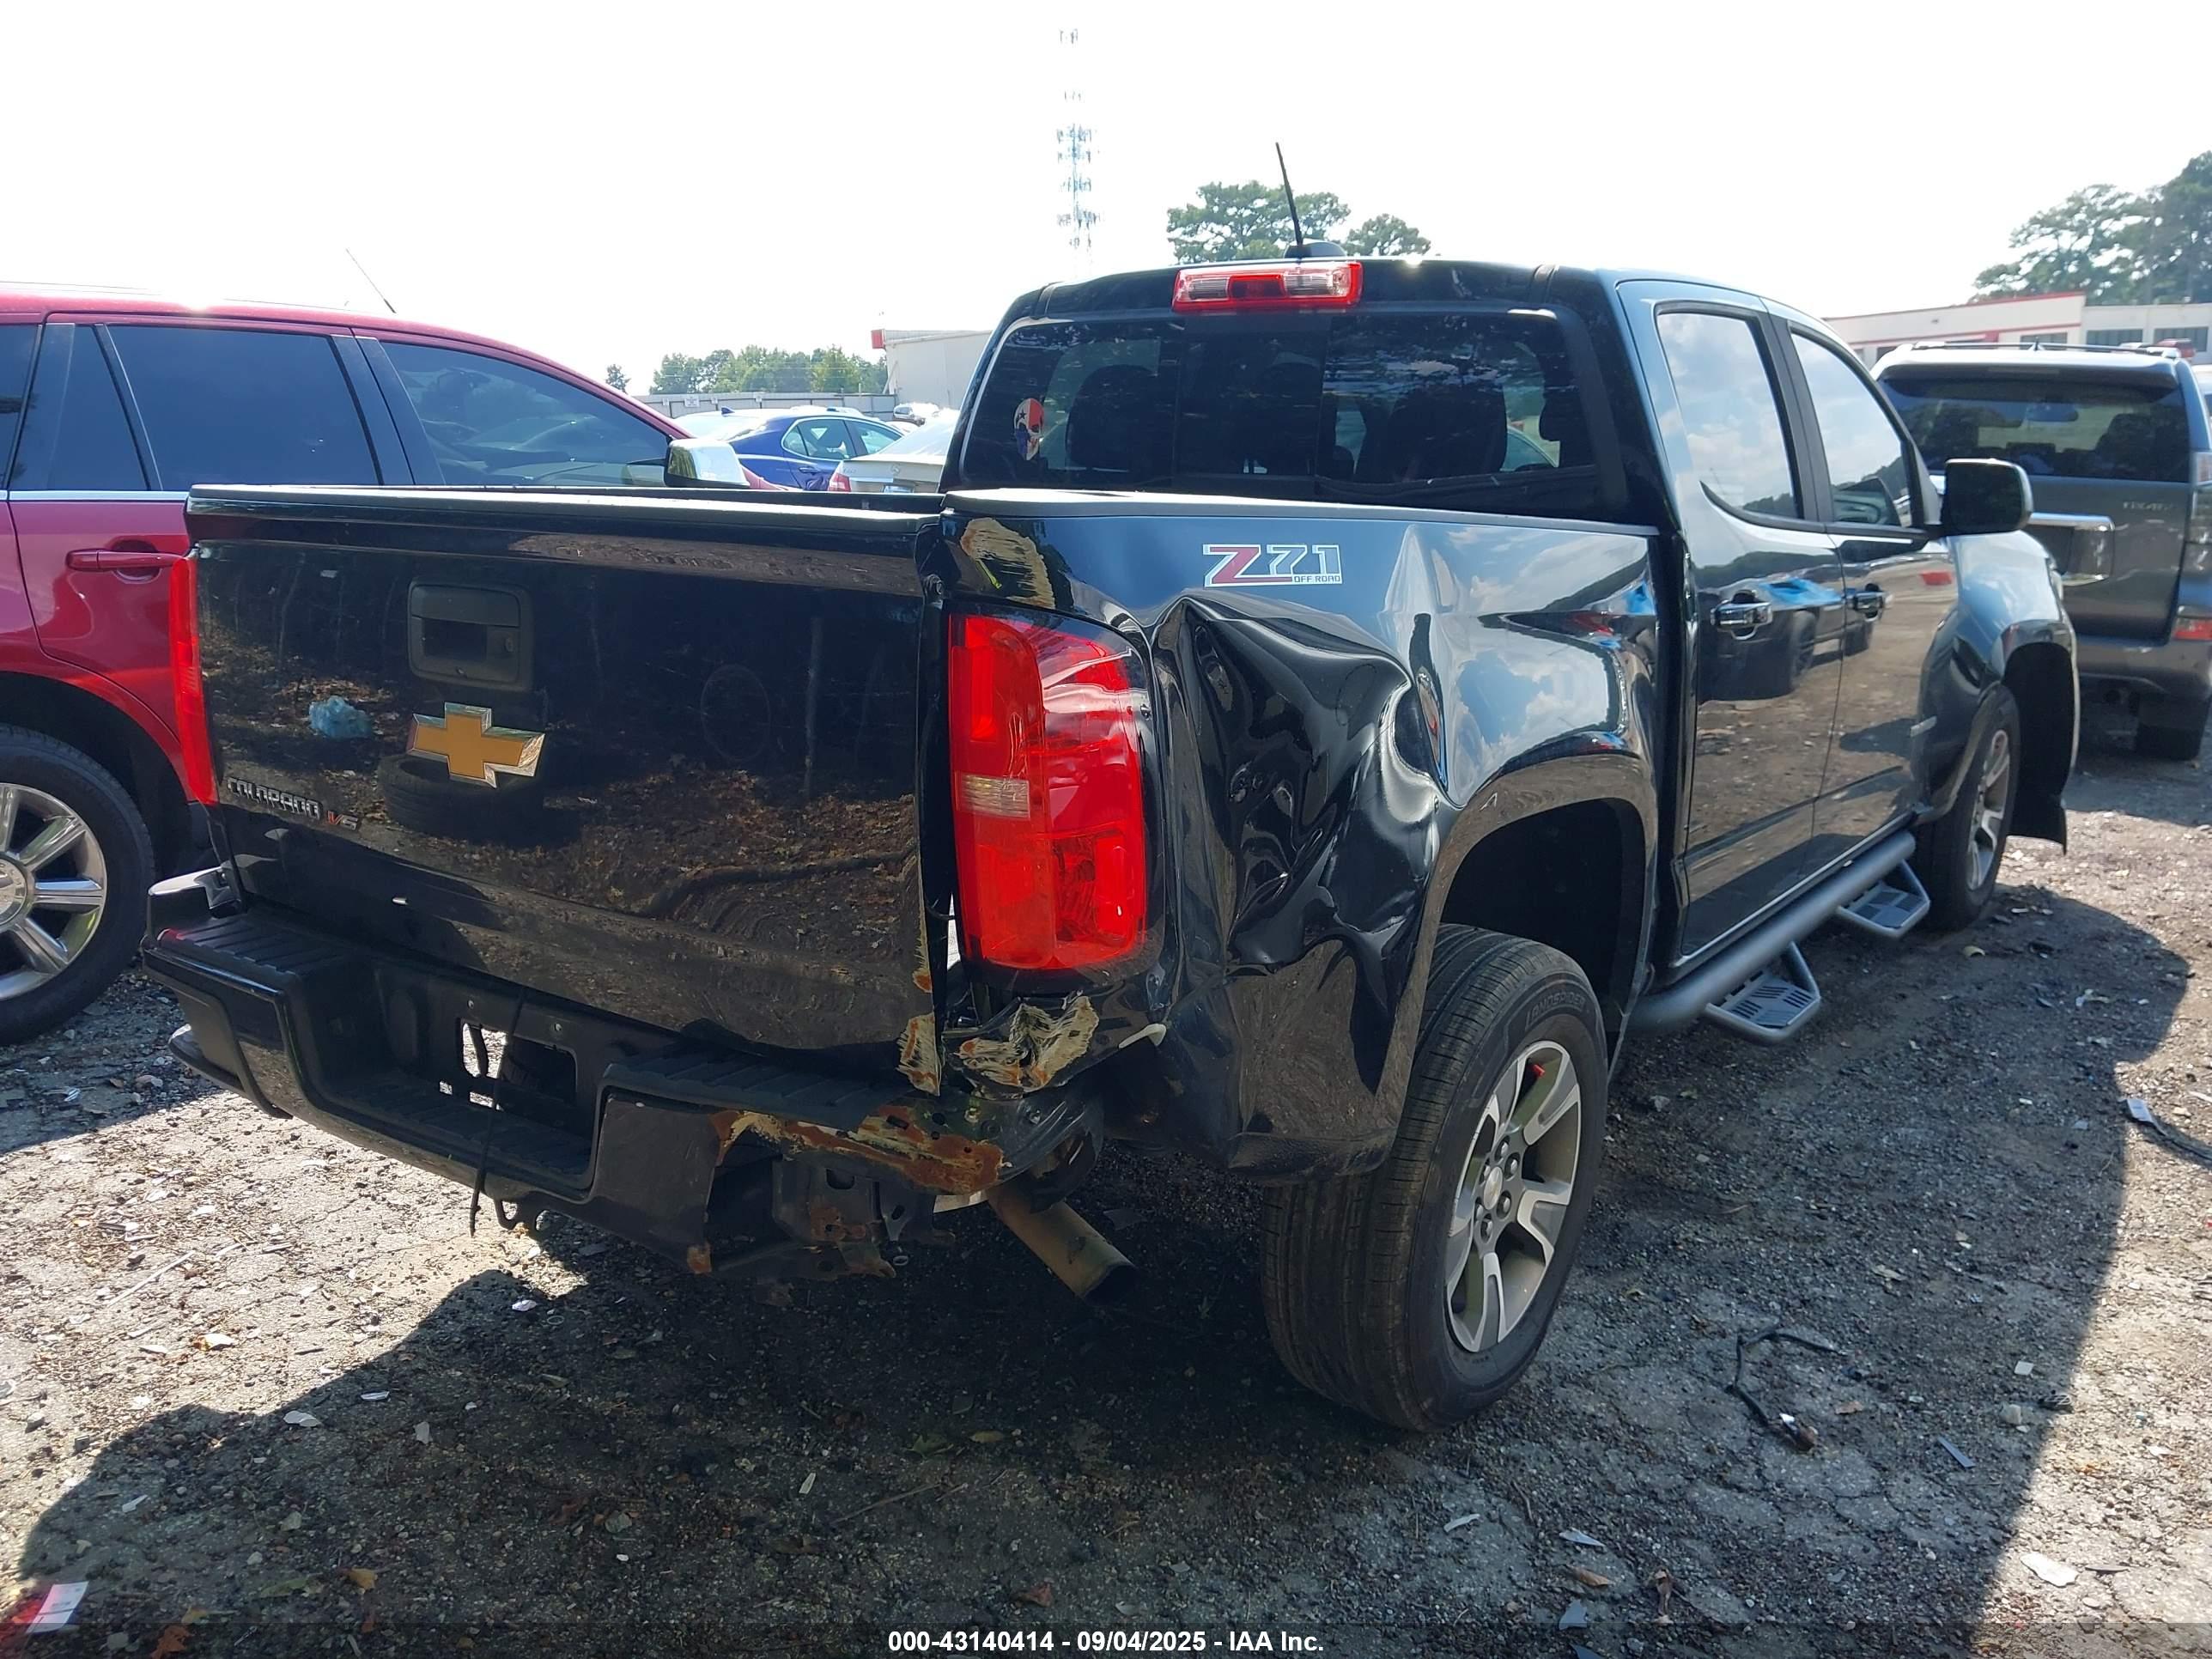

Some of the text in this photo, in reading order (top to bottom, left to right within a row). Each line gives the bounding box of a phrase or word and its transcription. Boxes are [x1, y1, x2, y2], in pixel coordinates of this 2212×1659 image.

[1202, 544, 1342, 586] Z71
[1315, 574, 1341, 583] ROAD
[326, 810, 359, 830] V6
